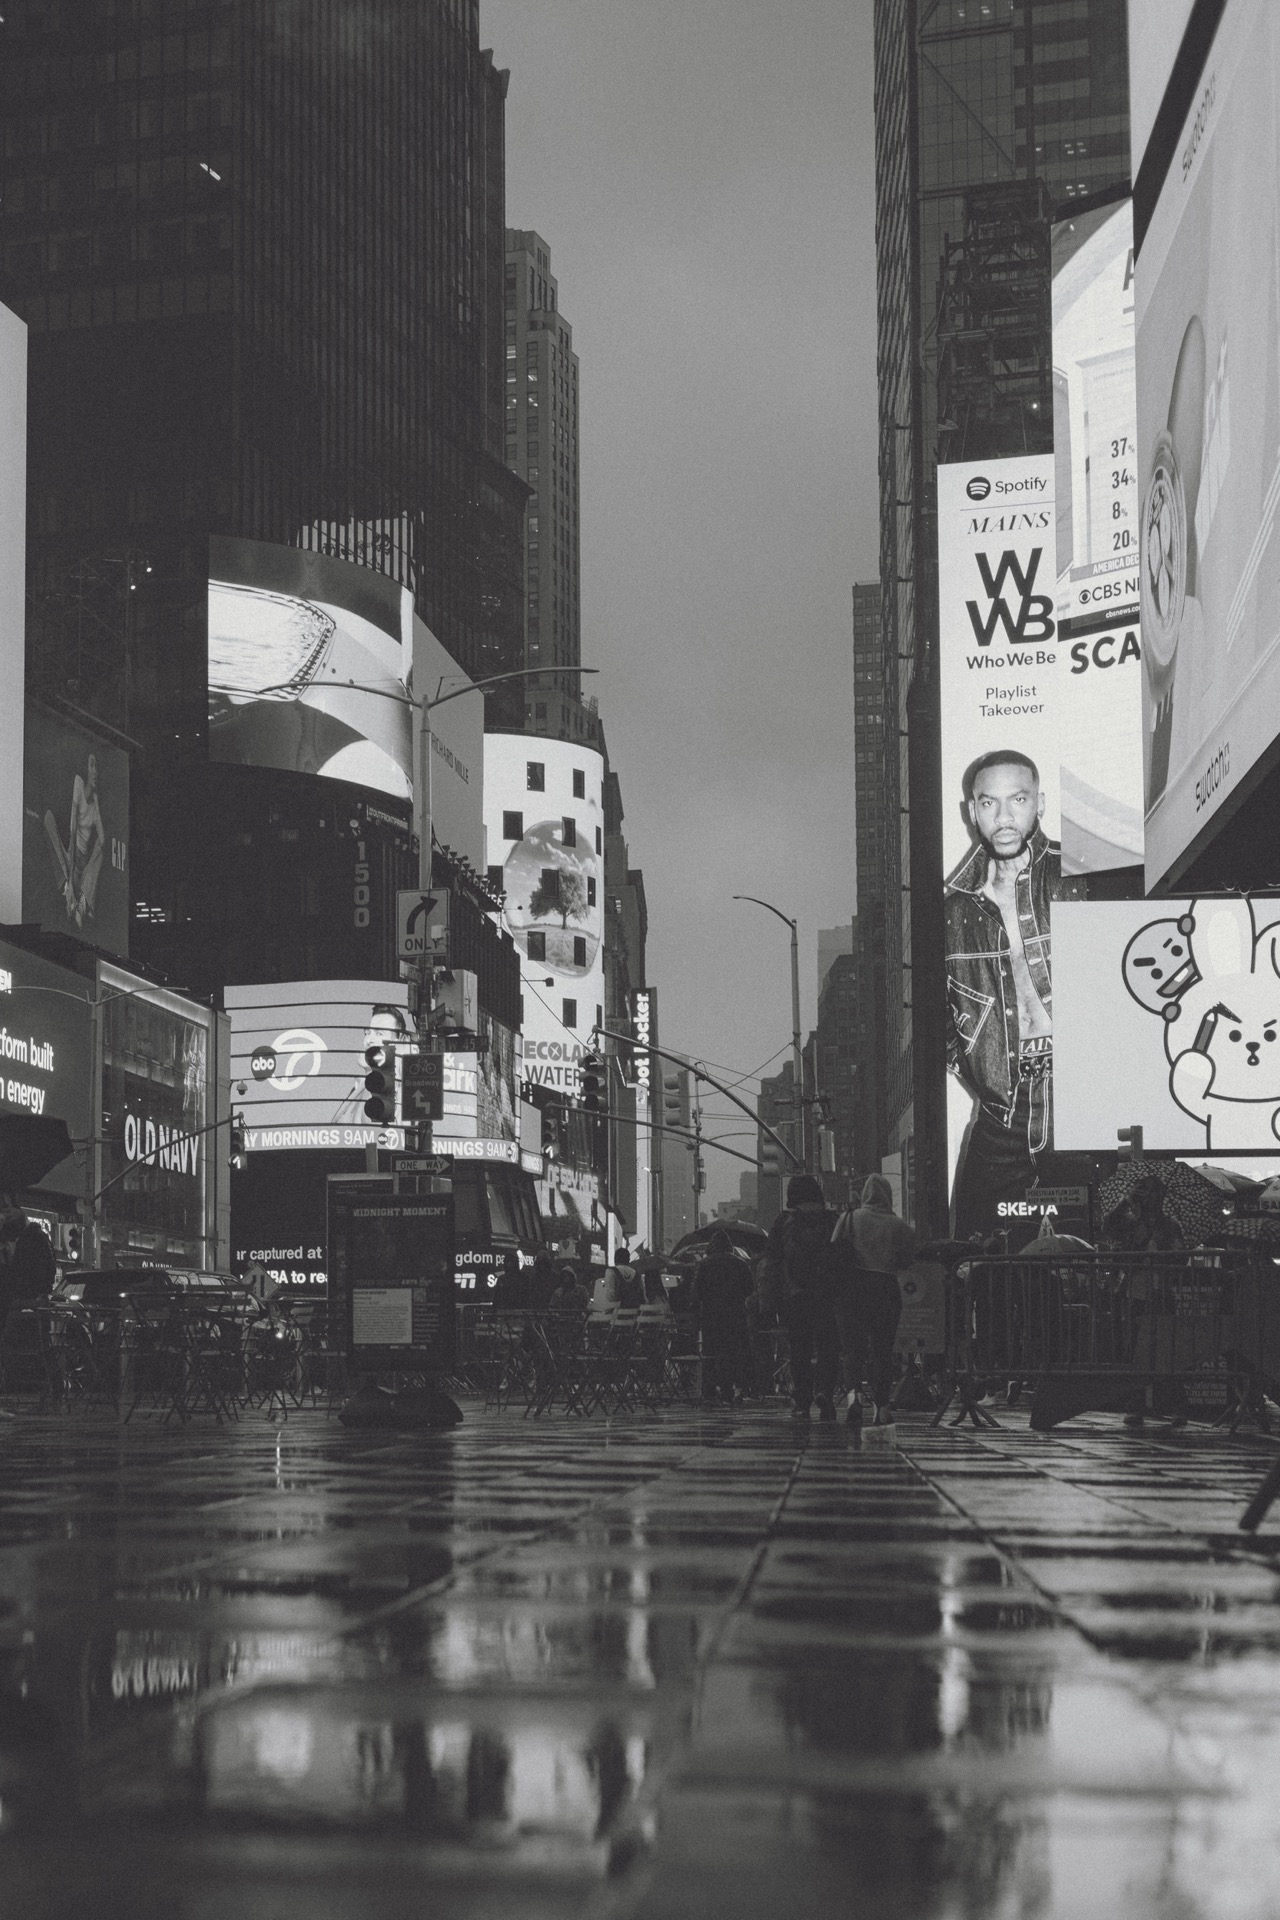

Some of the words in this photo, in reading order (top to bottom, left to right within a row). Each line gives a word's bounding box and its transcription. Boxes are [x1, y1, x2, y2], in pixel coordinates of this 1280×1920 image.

[995, 476, 1047, 495] Spotify
[967, 511, 1051, 535] MAINS
[1092, 556, 1125, 576] AMERICA
[1091, 580, 1122, 602] CBS
[966, 655, 1005, 669] Who
[1006, 652, 1033, 666] We
[1035, 650, 1056, 664] Be
[986, 685, 1037, 701] Playlist
[979, 703, 1045, 717] Takeover
[404, 938, 441, 952] ONLY
[448, 1039, 458, 1051] W
[463, 1038, 476, 1051] 45
[30, 1037, 54, 1071] built
[252, 1056, 275, 1071] abc
[405, 1079, 440, 1089] Broadway
[524, 1064, 581, 1087] WATER
[7, 1079, 45, 1115] energy
[124, 1113, 156, 1166] OLD
[159, 1123, 199, 1177] NAVY
[261, 1130, 340, 1148] MORNINGS
[344, 1129, 375, 1145] 9AM
[486, 1142, 506, 1157] 9AM
[400, 1161, 418, 1170] ONE
[426, 1160, 445, 1170] WAY
[353, 1207, 401, 1217] MIDNIGHT
[402, 1206, 447, 1217] MOMENT
[249, 1246, 303, 1264] captured
[307, 1246, 323, 1260] at
[455, 1250, 493, 1267] gdom
[290, 1269, 307, 1285] to
